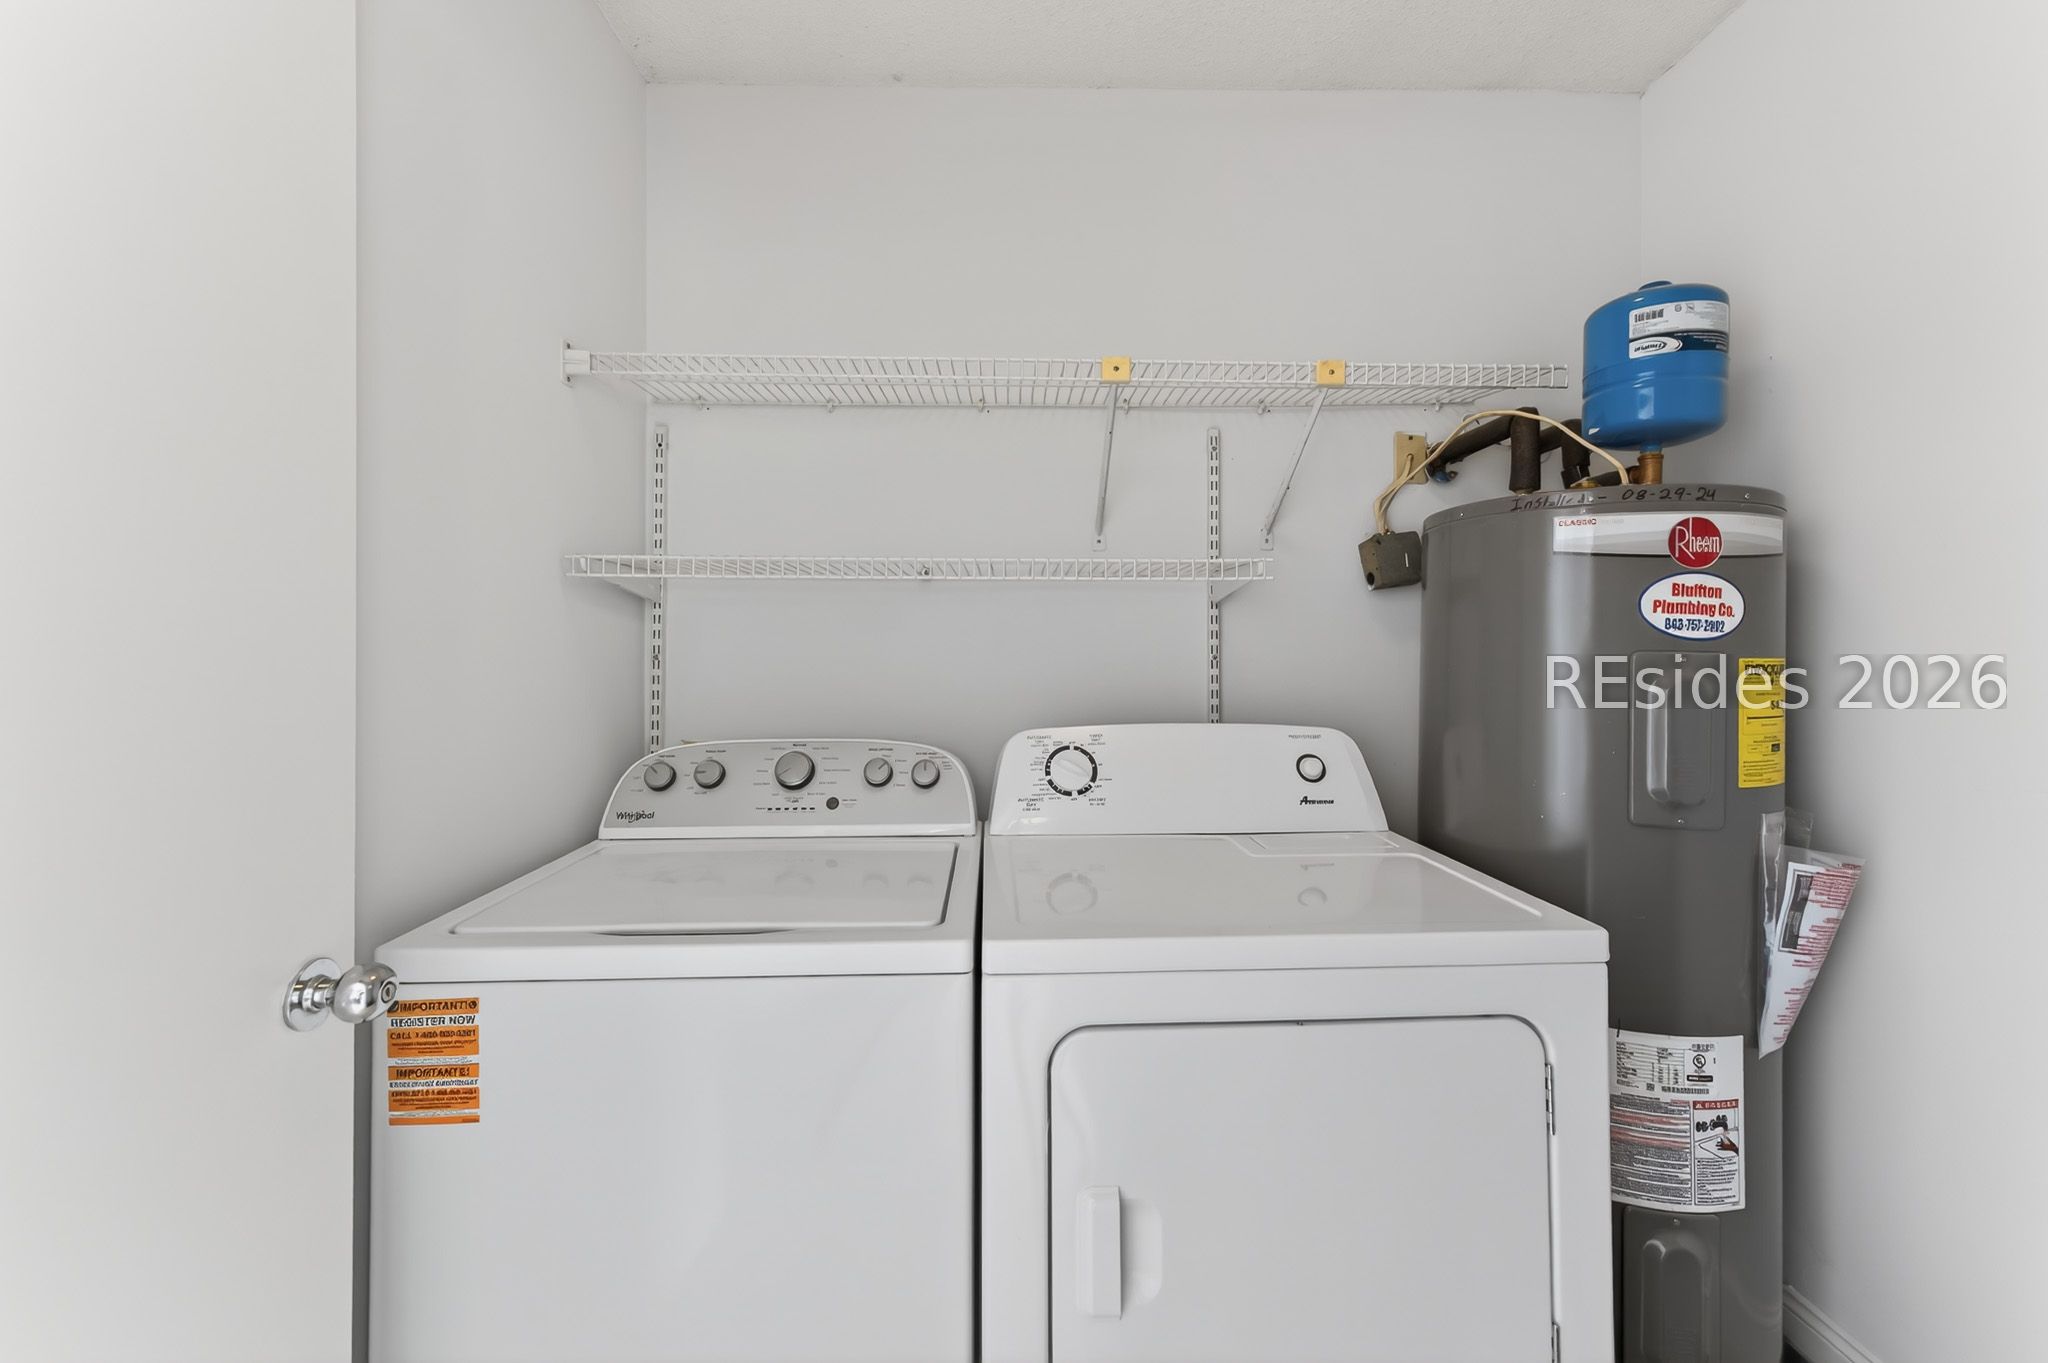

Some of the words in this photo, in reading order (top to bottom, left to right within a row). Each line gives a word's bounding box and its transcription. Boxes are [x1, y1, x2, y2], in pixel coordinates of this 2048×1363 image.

[1621, 487, 1717, 502] 08-29-24
[1674, 517, 1720, 560] Rheem
[1671, 582, 1723, 600] Bluffton
[1652, 599, 1716, 617] Plumbing
[1718, 602, 1735, 617] Co.
[616, 810, 656, 824] Whirlpool
[390, 1016, 446, 1028] REGISTER
[449, 1015, 476, 1025] NOW
